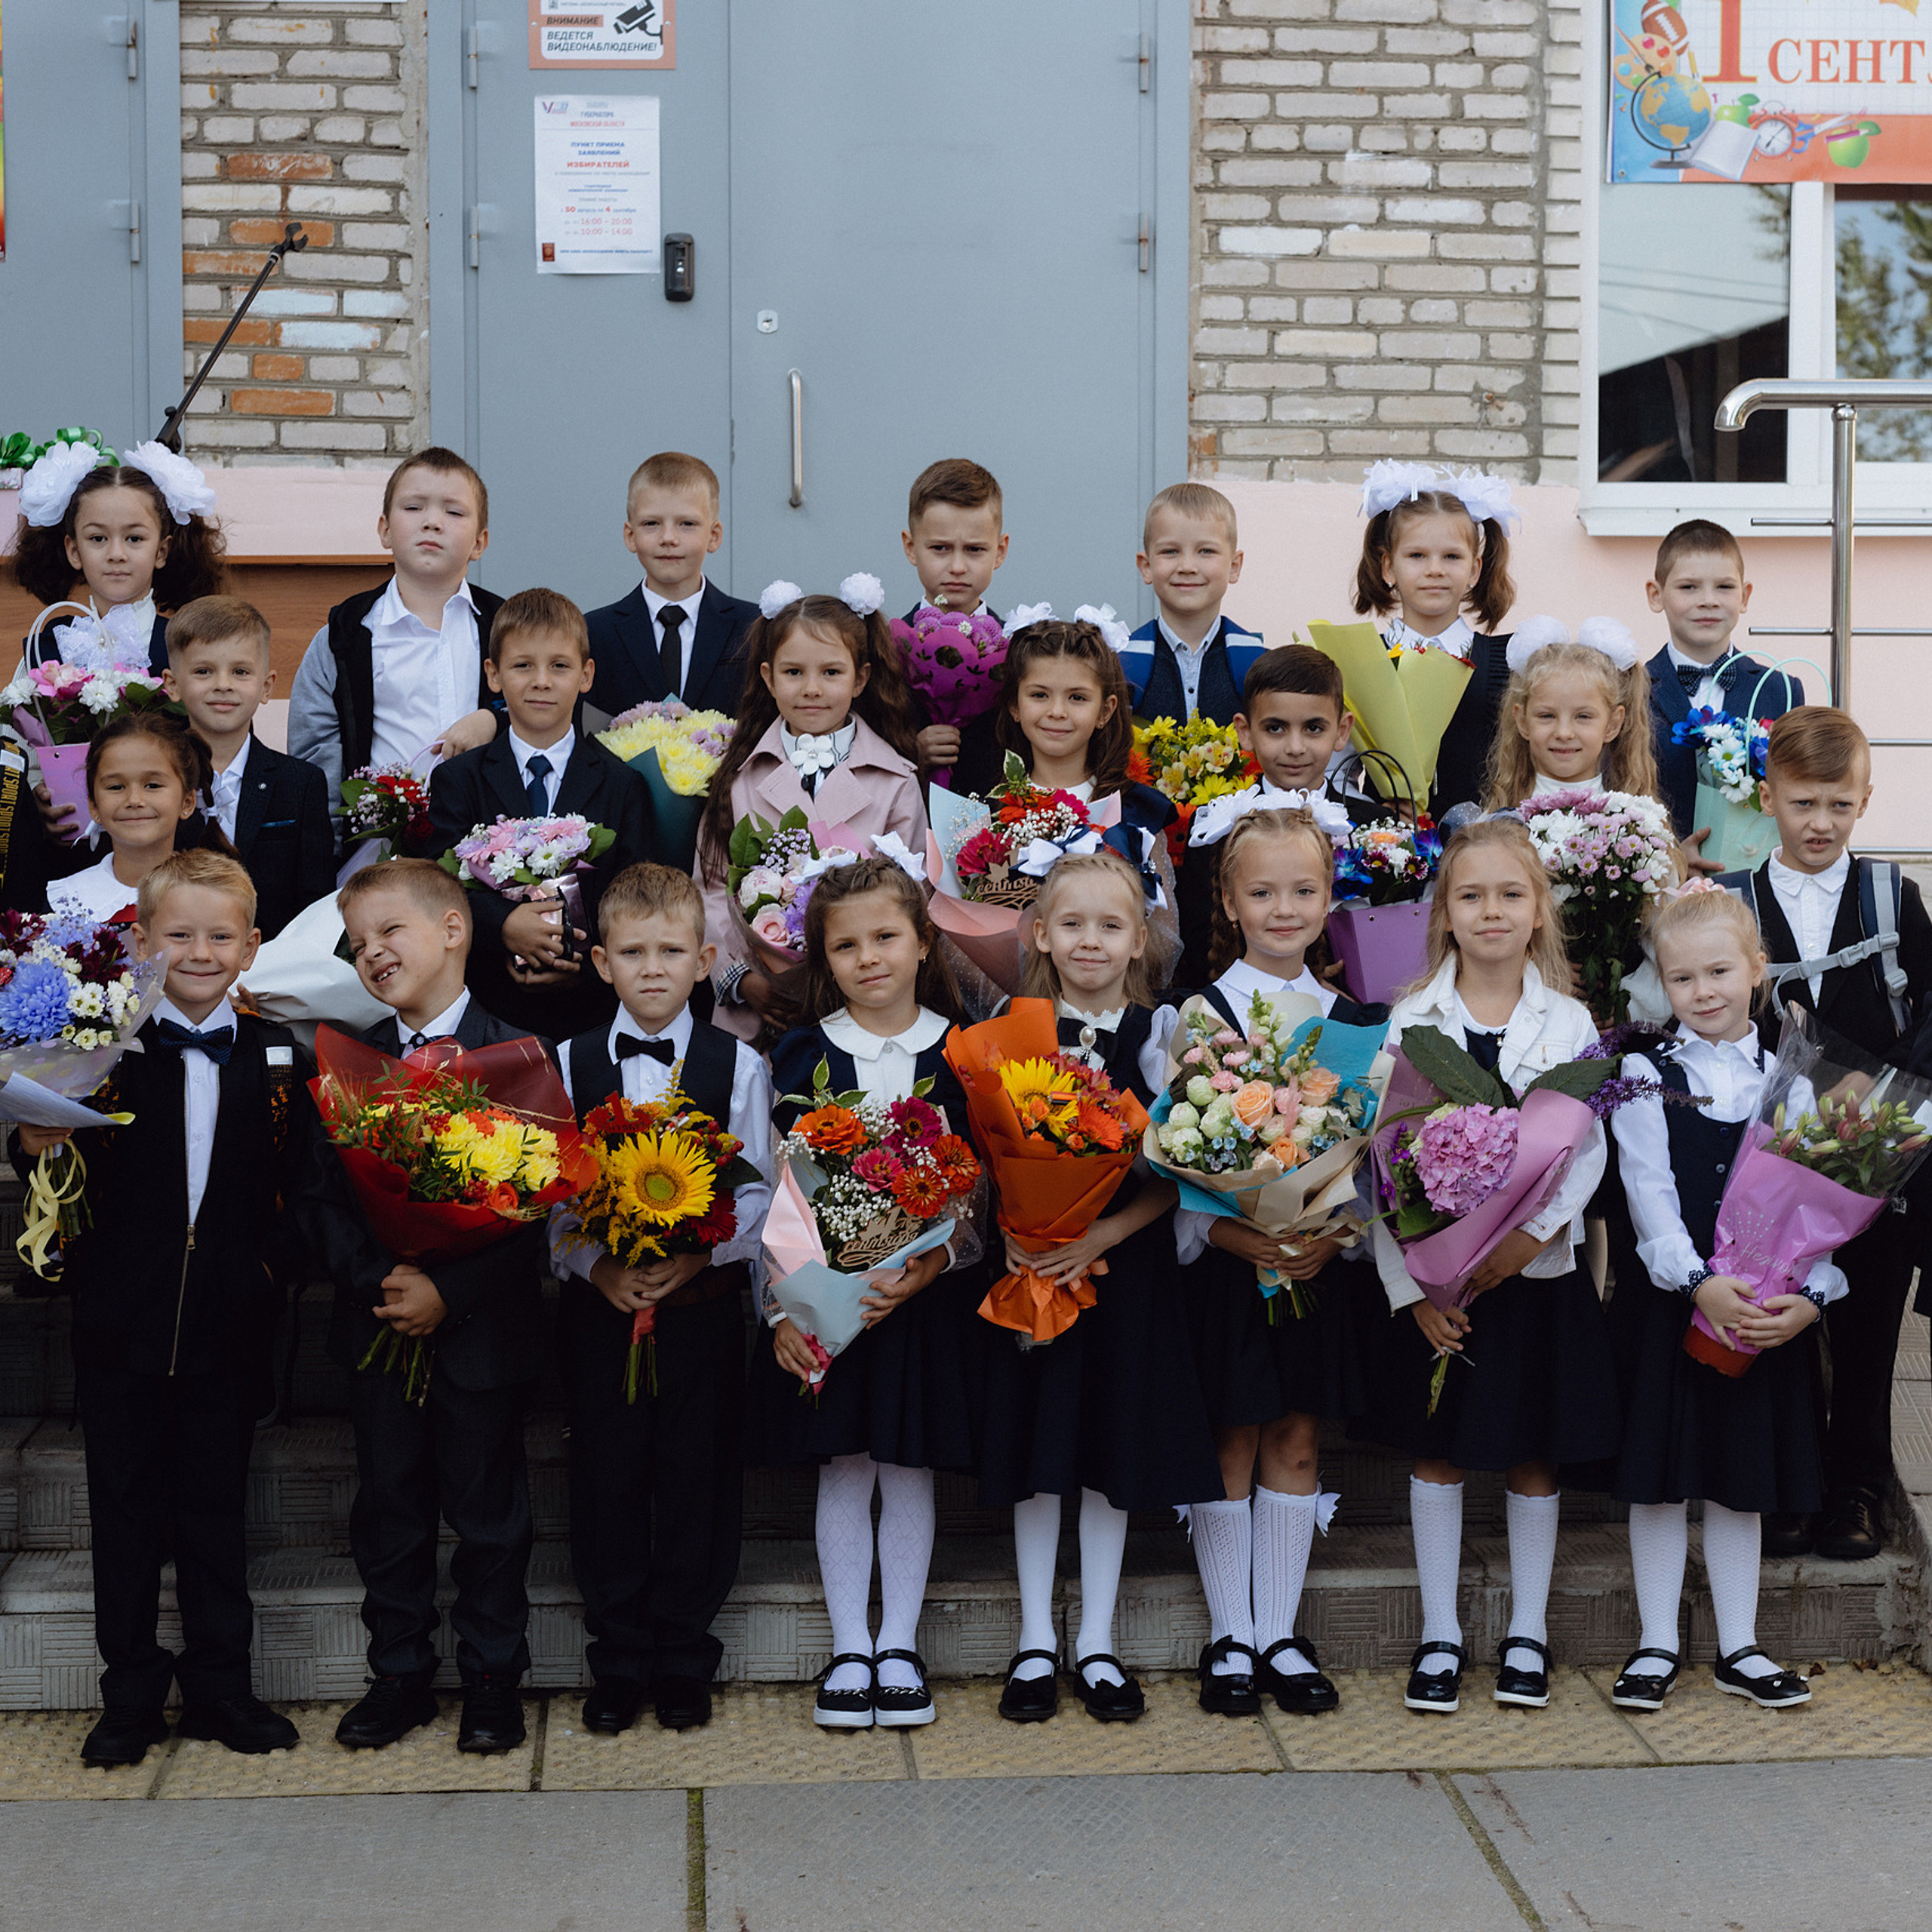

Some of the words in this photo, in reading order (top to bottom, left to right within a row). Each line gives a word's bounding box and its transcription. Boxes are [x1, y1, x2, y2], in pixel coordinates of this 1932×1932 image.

[546, 17, 599, 25] ВНИМАНИЕ
[547, 31, 594, 41] ВЕДЕТСЯ
[547, 42, 657, 52] ВИДЕОНАБЛЮДЕНИЕ!
[1768, 38, 1932, 84] СЕНТ
